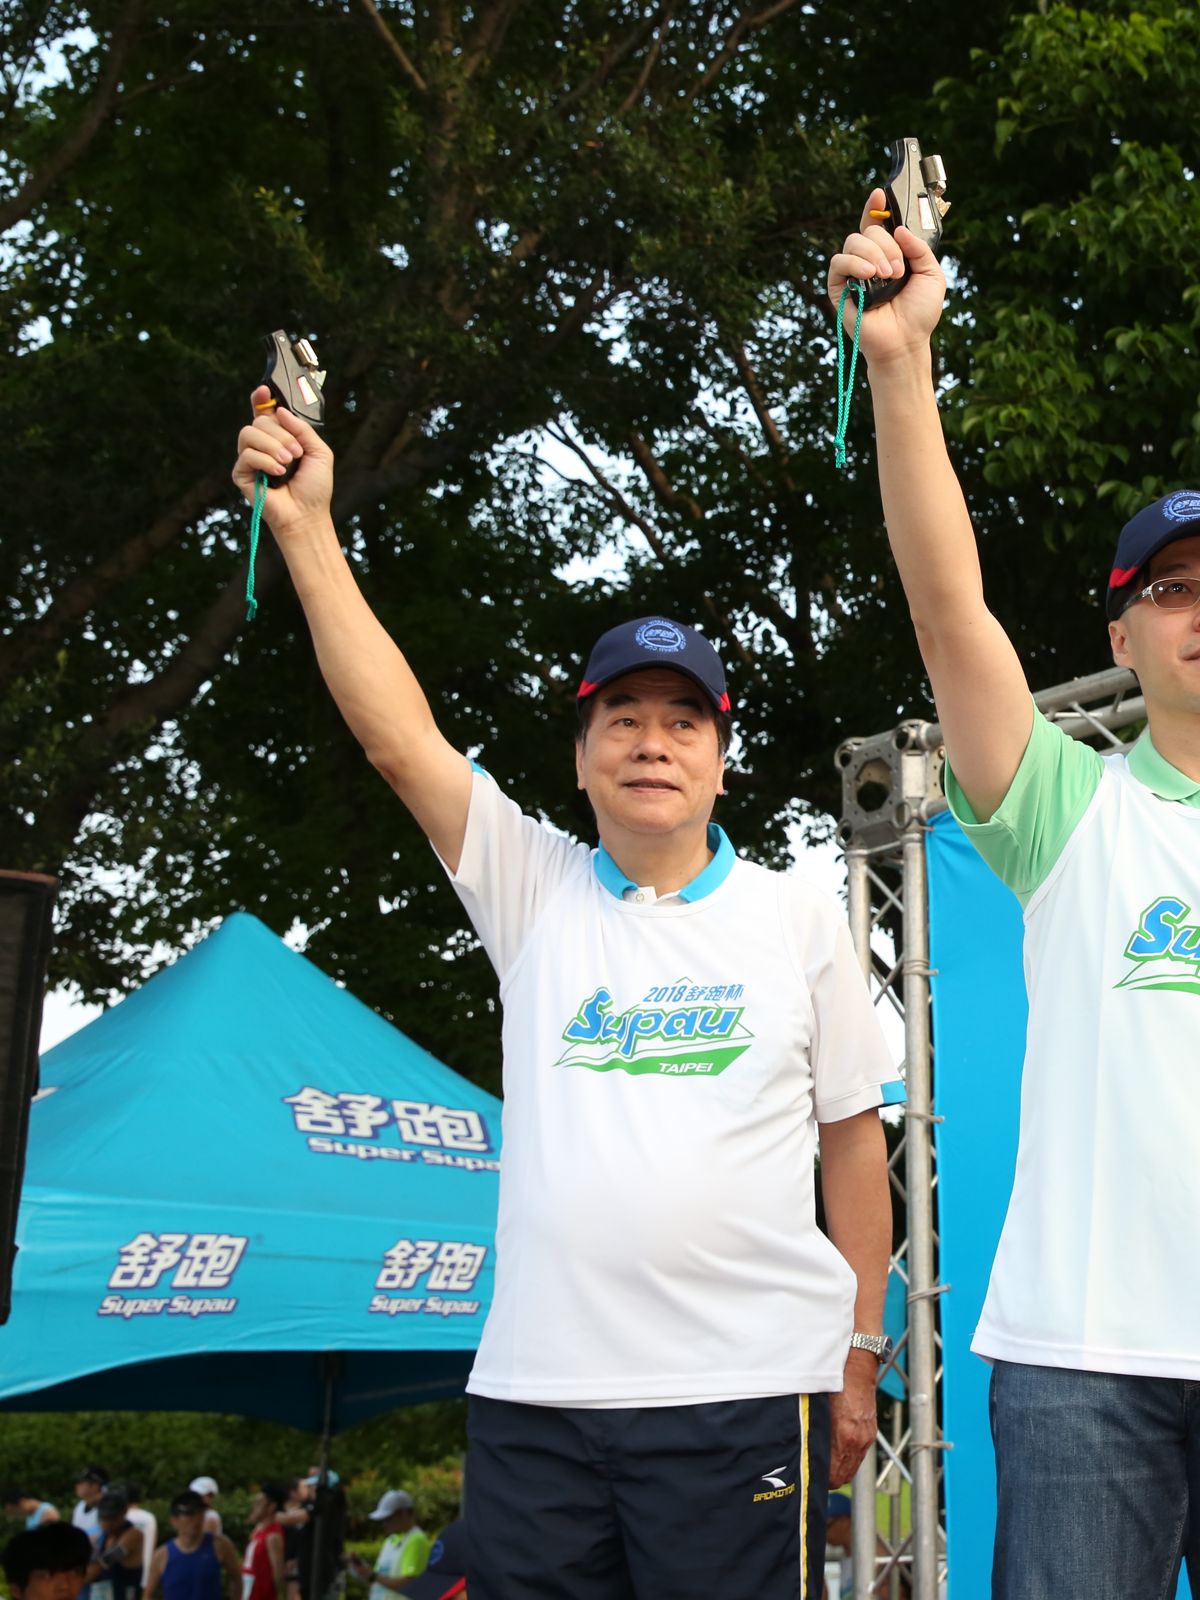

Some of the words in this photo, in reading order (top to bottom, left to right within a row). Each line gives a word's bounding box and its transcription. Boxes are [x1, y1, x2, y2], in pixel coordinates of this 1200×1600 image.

[564, 987, 742, 1057] Supau
[658, 1062, 714, 1073] TAIPEI
[283, 1086, 490, 1153] 舒跑
[307, 1136, 417, 1161] Super
[421, 1149, 500, 1172] Supa
[108, 1232, 248, 1289] 舒跑
[375, 1239, 488, 1291] 舒跑
[98, 1295, 170, 1319] Super
[168, 1295, 238, 1317] Supau
[369, 1294, 425, 1315] Super
[424, 1297, 480, 1316] Supau
